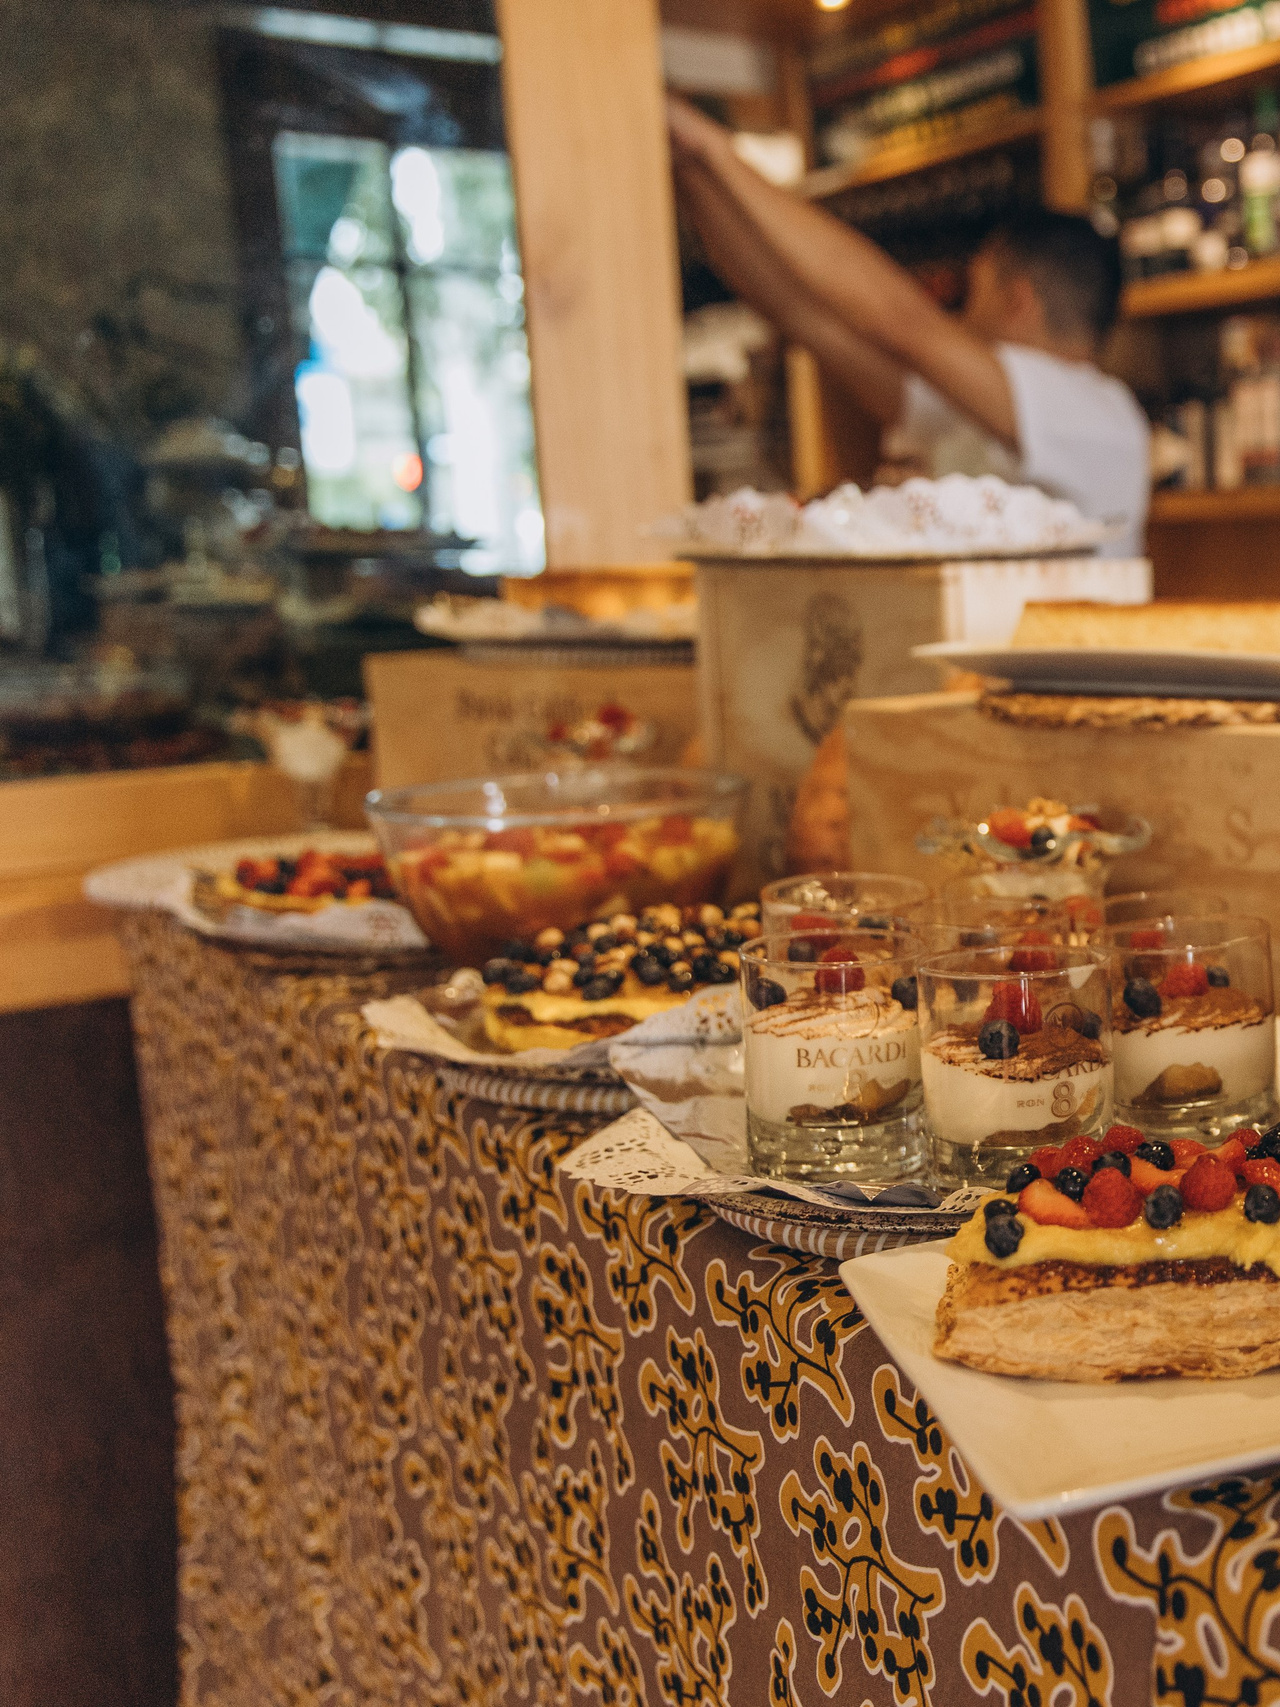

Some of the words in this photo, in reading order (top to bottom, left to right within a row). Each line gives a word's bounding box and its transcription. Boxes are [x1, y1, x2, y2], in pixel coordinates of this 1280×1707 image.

[796, 1040, 907, 1069] BACARDI
[1017, 1099, 1045, 1108] RON
[1051, 1080, 1078, 1118] 8
